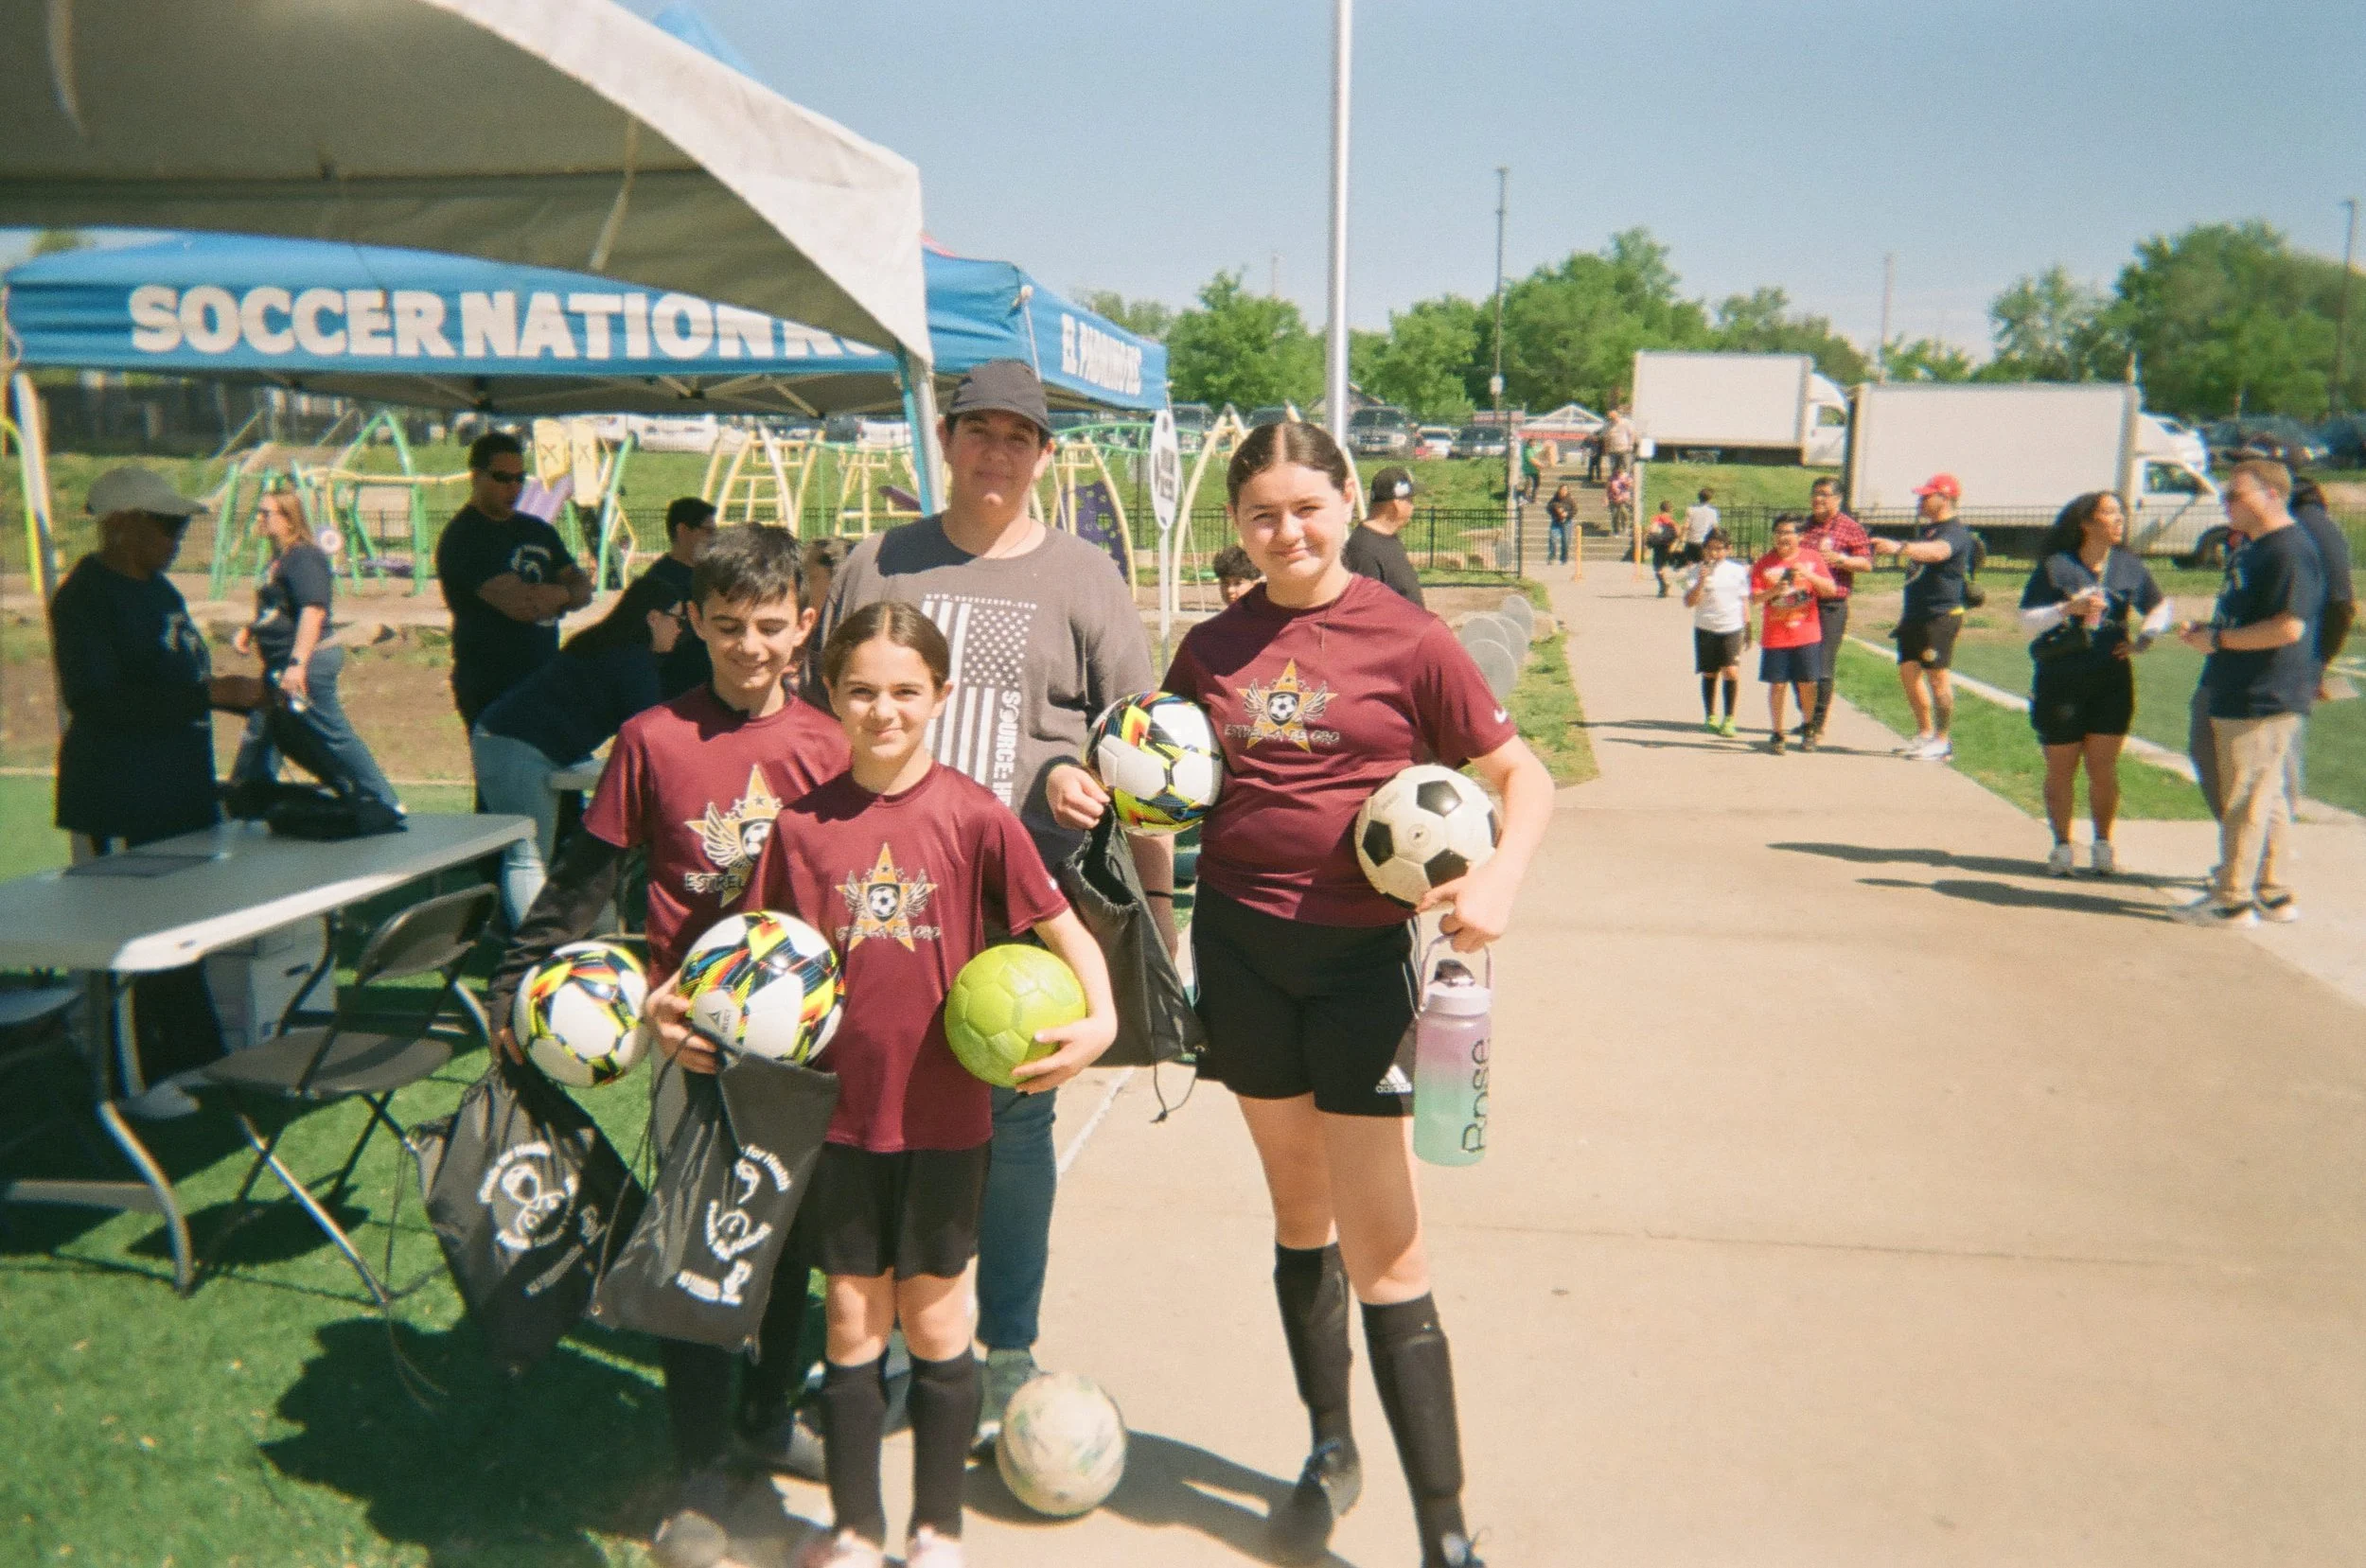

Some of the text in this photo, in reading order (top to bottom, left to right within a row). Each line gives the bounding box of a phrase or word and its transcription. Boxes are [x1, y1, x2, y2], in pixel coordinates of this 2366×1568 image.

[128, 284, 455, 356] SOCCER
[460, 291, 773, 360] NATION
[994, 690, 1021, 780] SOURCE
